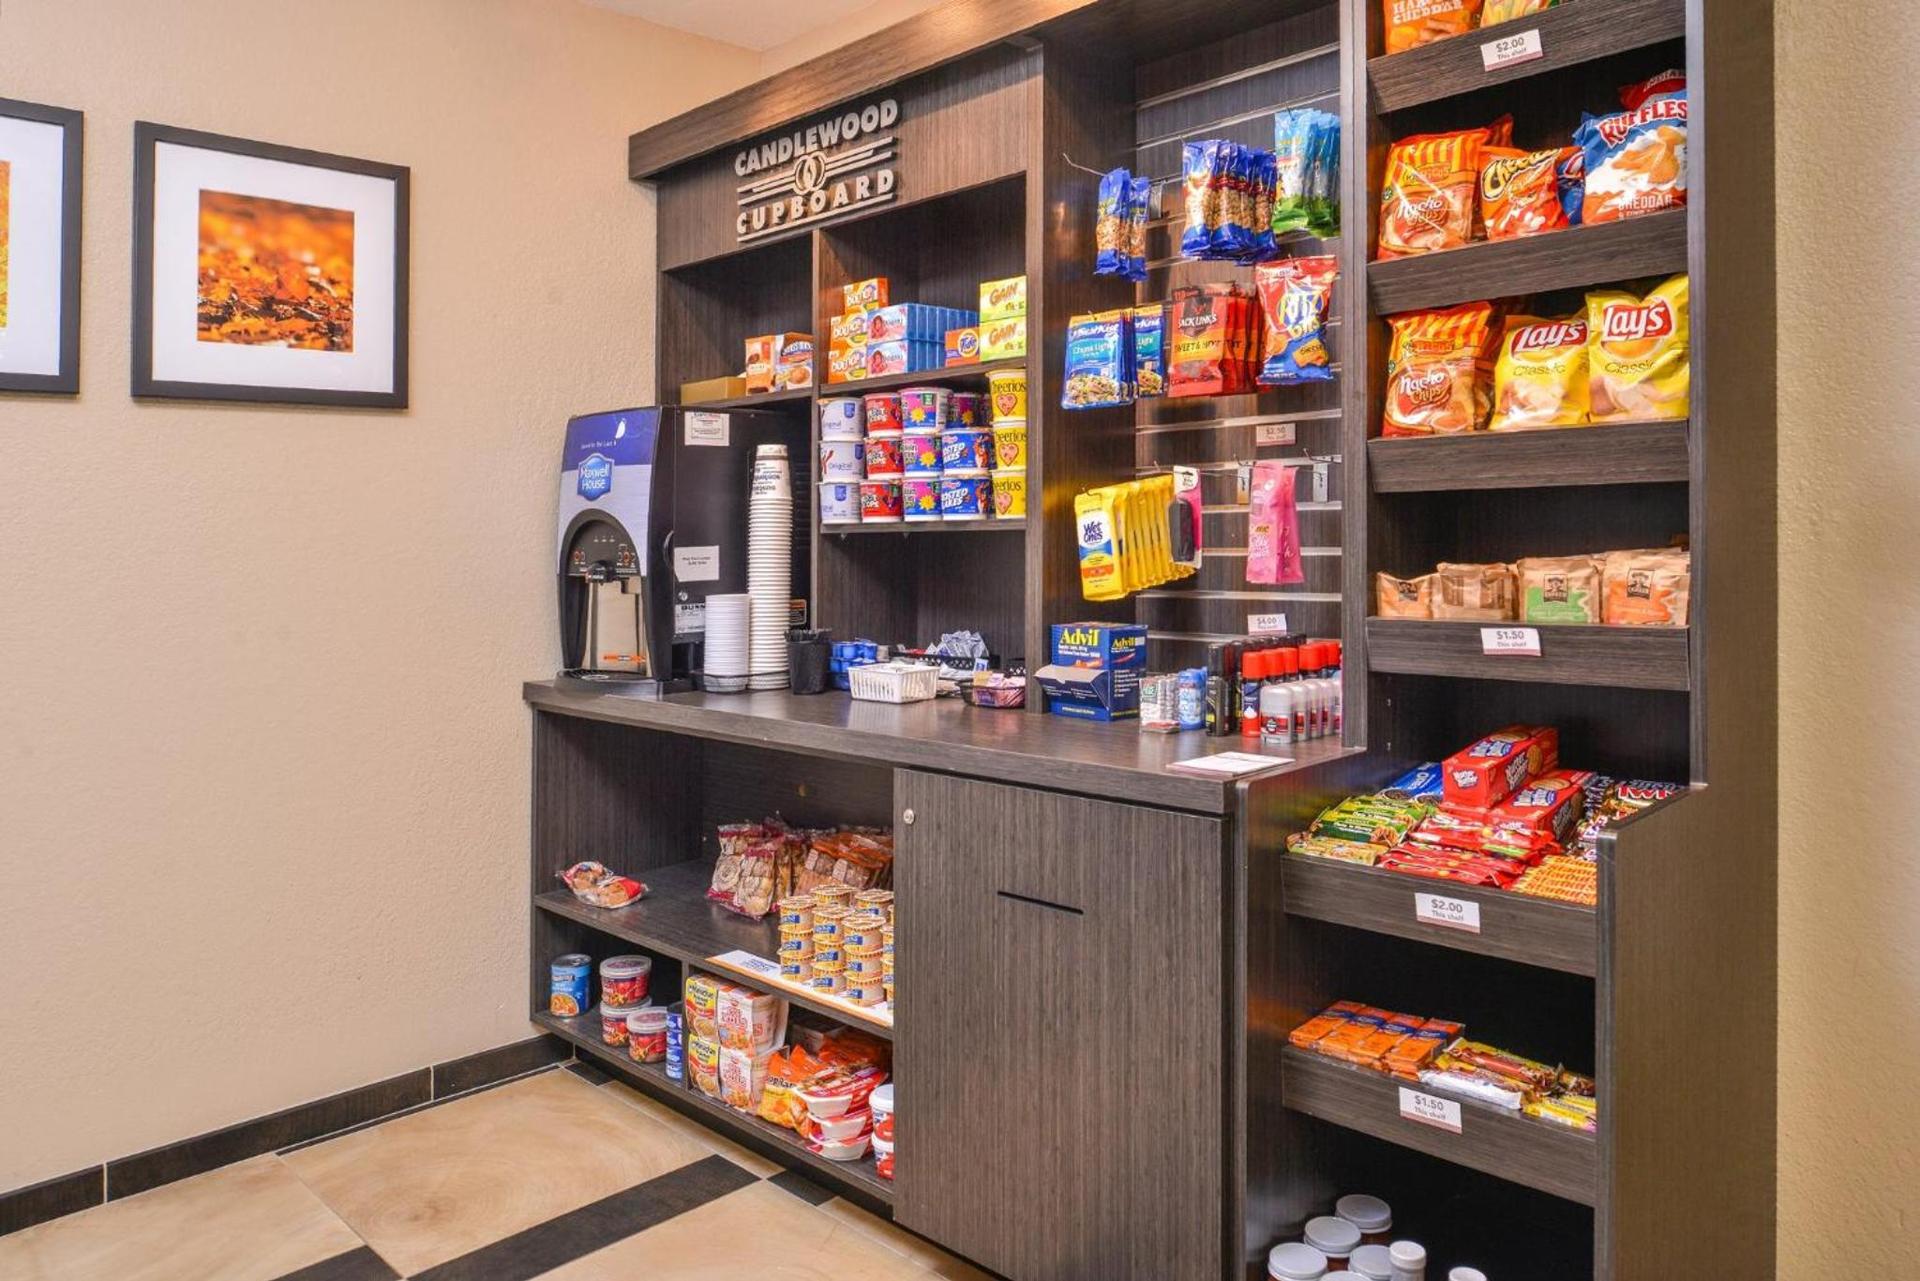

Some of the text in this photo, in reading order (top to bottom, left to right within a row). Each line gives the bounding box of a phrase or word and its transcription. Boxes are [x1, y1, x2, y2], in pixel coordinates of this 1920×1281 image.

[1496, 37, 1525, 53] $2.00
[735, 99, 898, 177] CANDLEWOOD
[737, 168, 894, 234] CUPBOARD
[1083, 520, 1103, 536] Wet
[1060, 628, 1101, 647] Advil
[1110, 637, 1136, 649] Advil
[1496, 630, 1525, 641] $1.50
[1431, 898, 1463, 914] $2.00
[1414, 1094, 1444, 1111] $1.50
